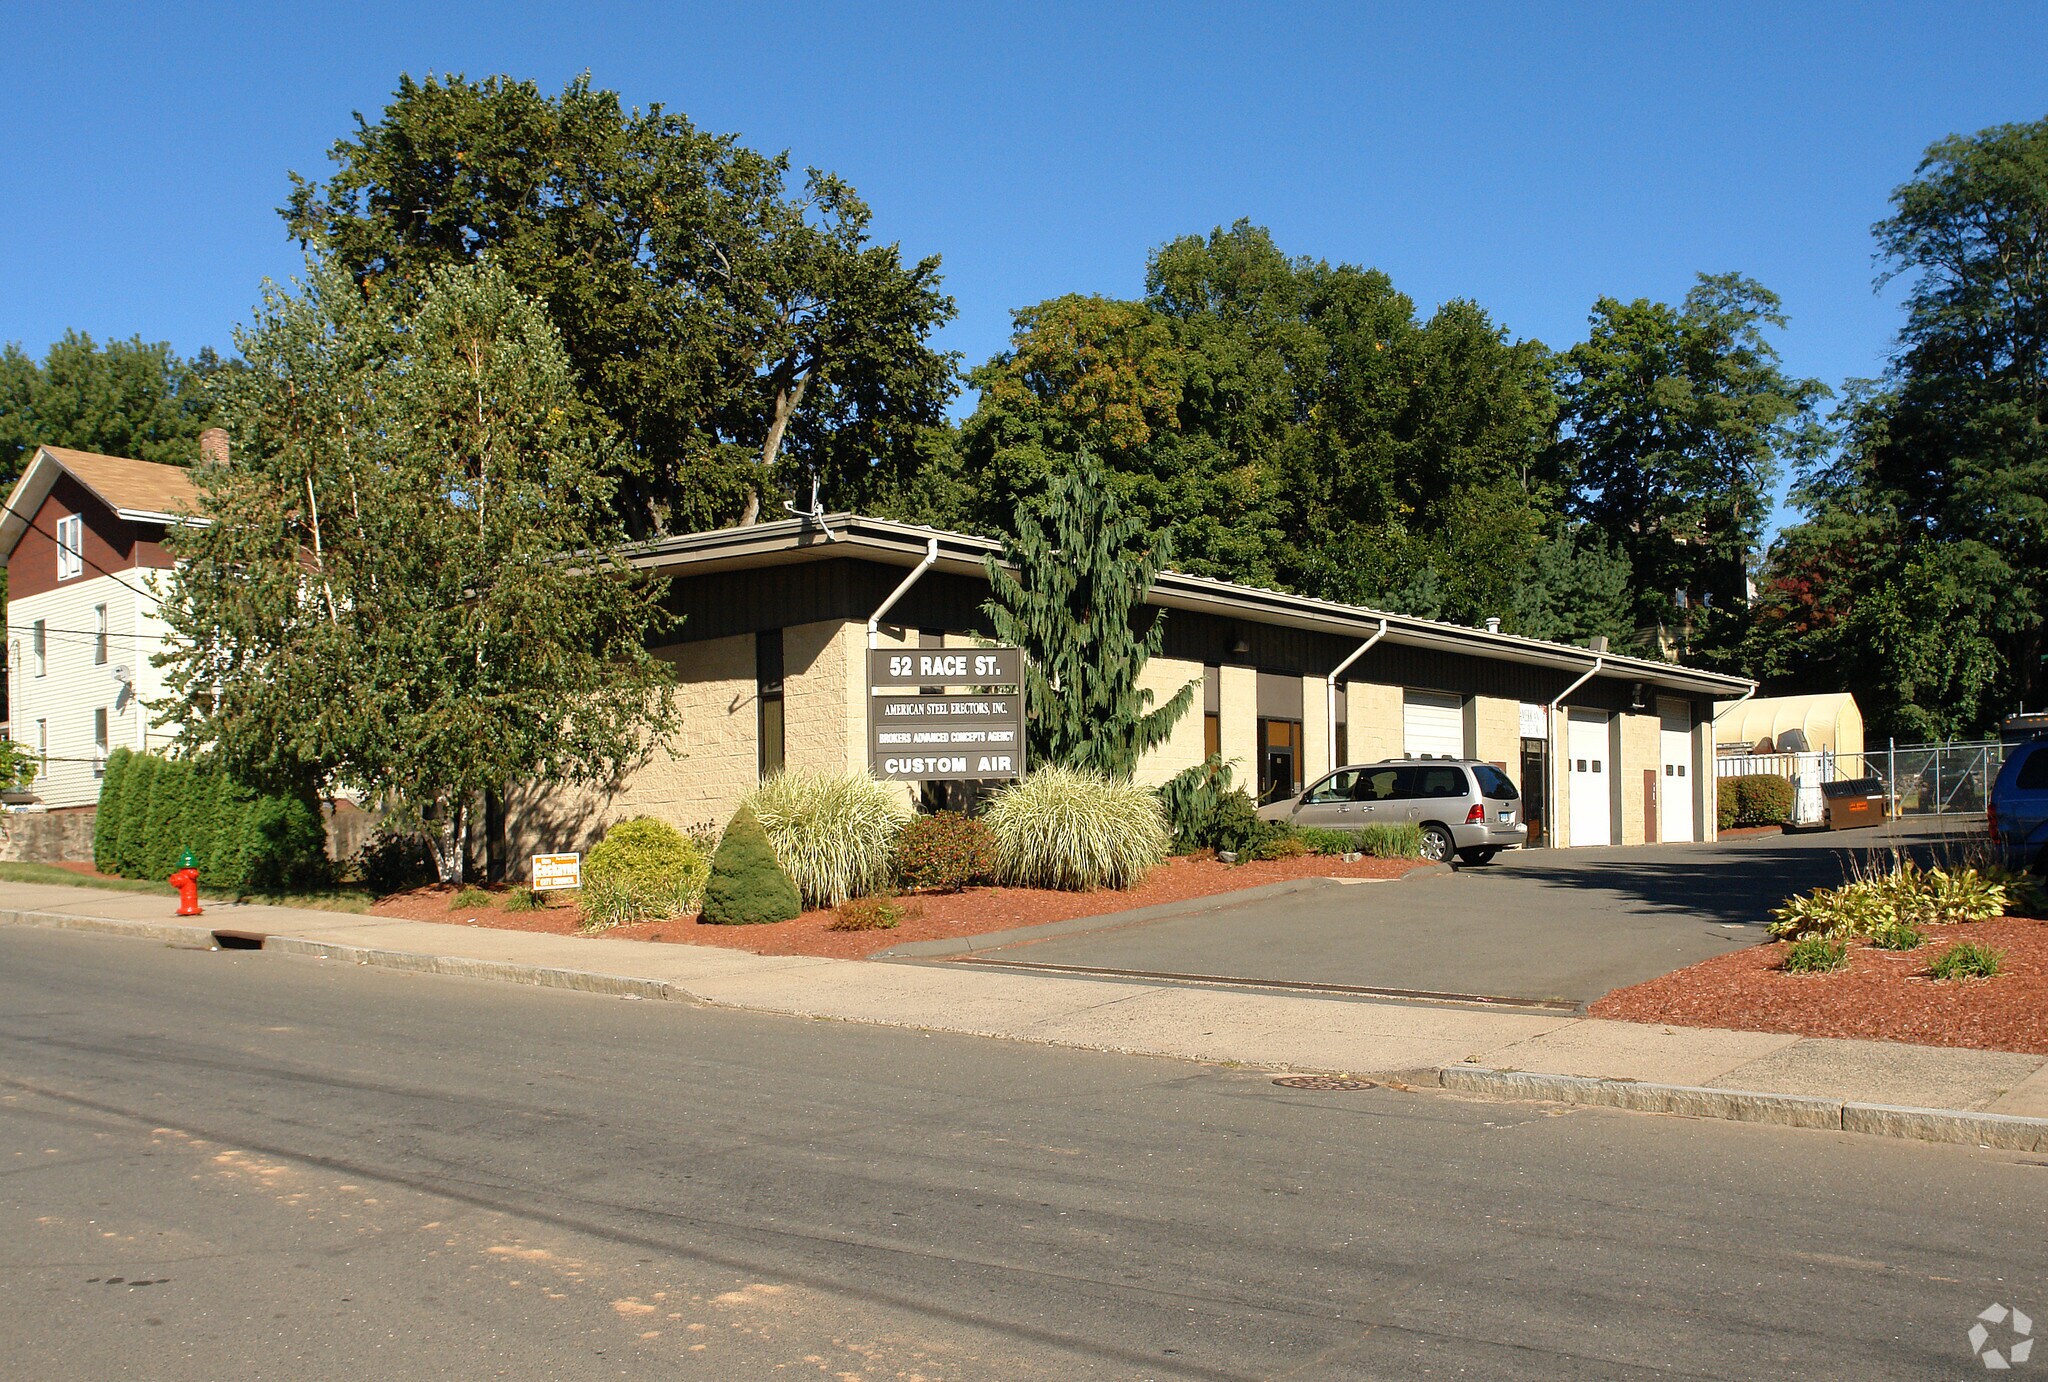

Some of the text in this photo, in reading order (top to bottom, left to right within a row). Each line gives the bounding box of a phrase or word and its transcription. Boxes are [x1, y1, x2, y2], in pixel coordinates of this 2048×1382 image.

[889, 655, 1001, 677] 52 RACE ST.
[884, 702, 1008, 716] AMERICAN STEEL ERECTORS, INC.
[878, 731, 1014, 744] BROKERS ADVANCED CONCEPTS AGENCY
[884, 756, 1012, 774] CUSTOM AIR
